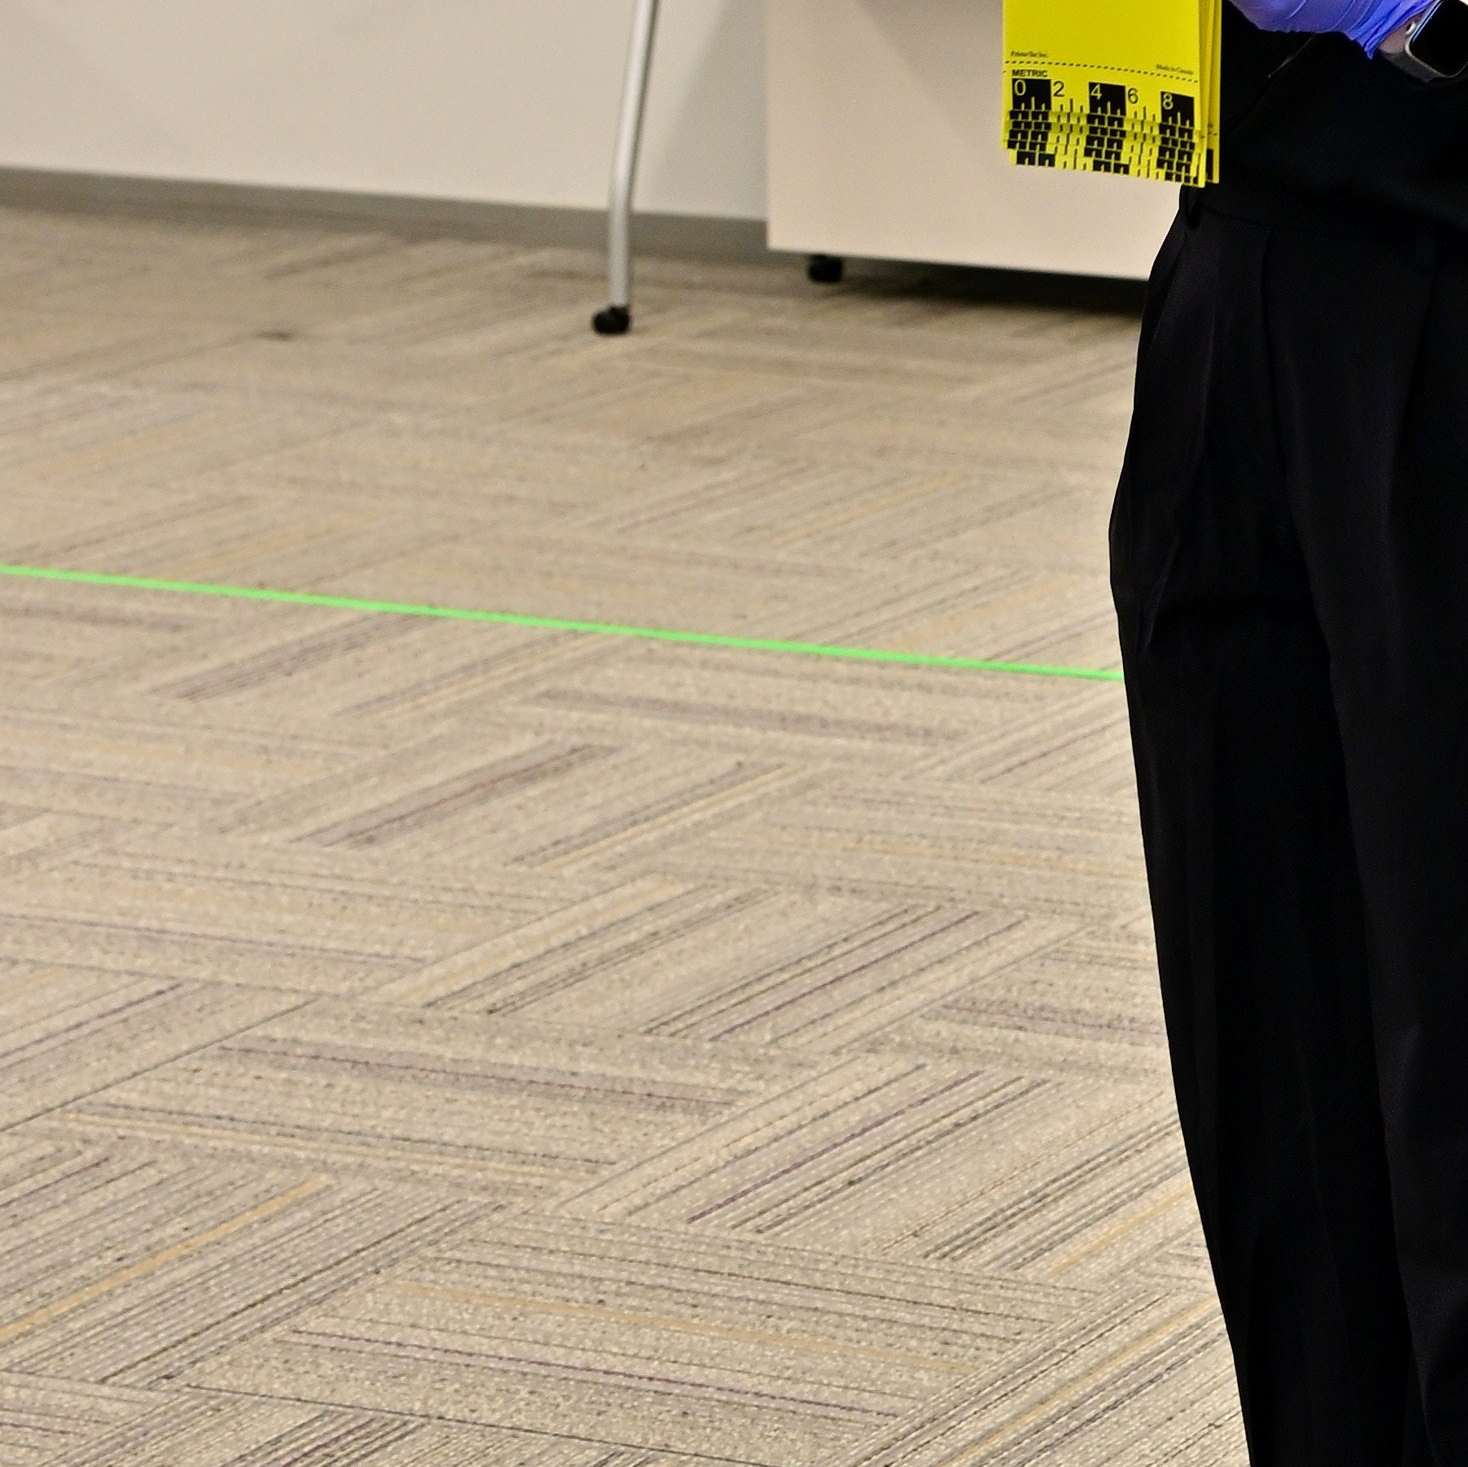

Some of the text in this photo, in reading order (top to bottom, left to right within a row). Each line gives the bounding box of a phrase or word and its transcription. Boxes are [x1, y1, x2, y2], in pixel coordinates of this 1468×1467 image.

[1011, 69, 1049, 78] METRIC
[1014, 79, 1174, 110] 0 2 4 6 8
